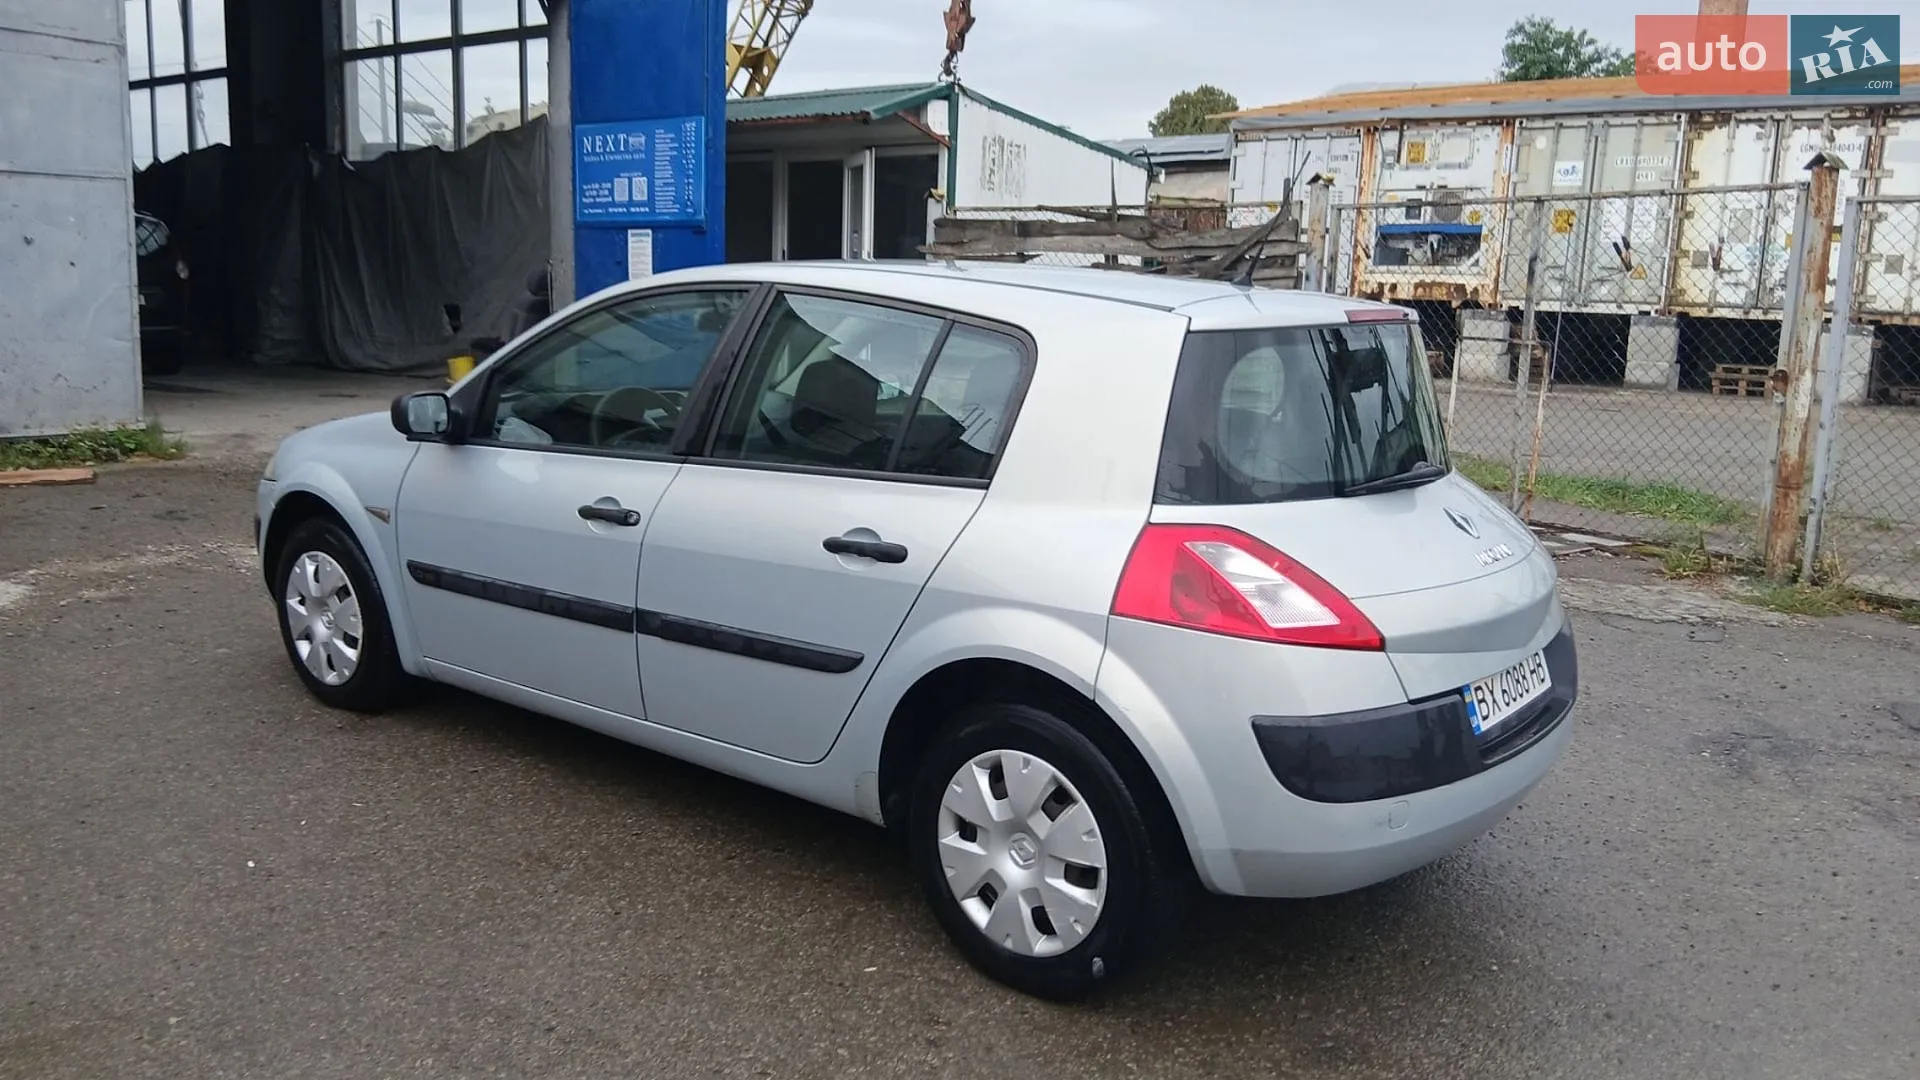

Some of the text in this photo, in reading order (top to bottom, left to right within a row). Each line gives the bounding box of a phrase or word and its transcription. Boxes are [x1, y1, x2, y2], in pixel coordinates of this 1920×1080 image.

[583, 133, 627, 154] NEXT
[1474, 652, 1546, 721] BX 6088 HB
